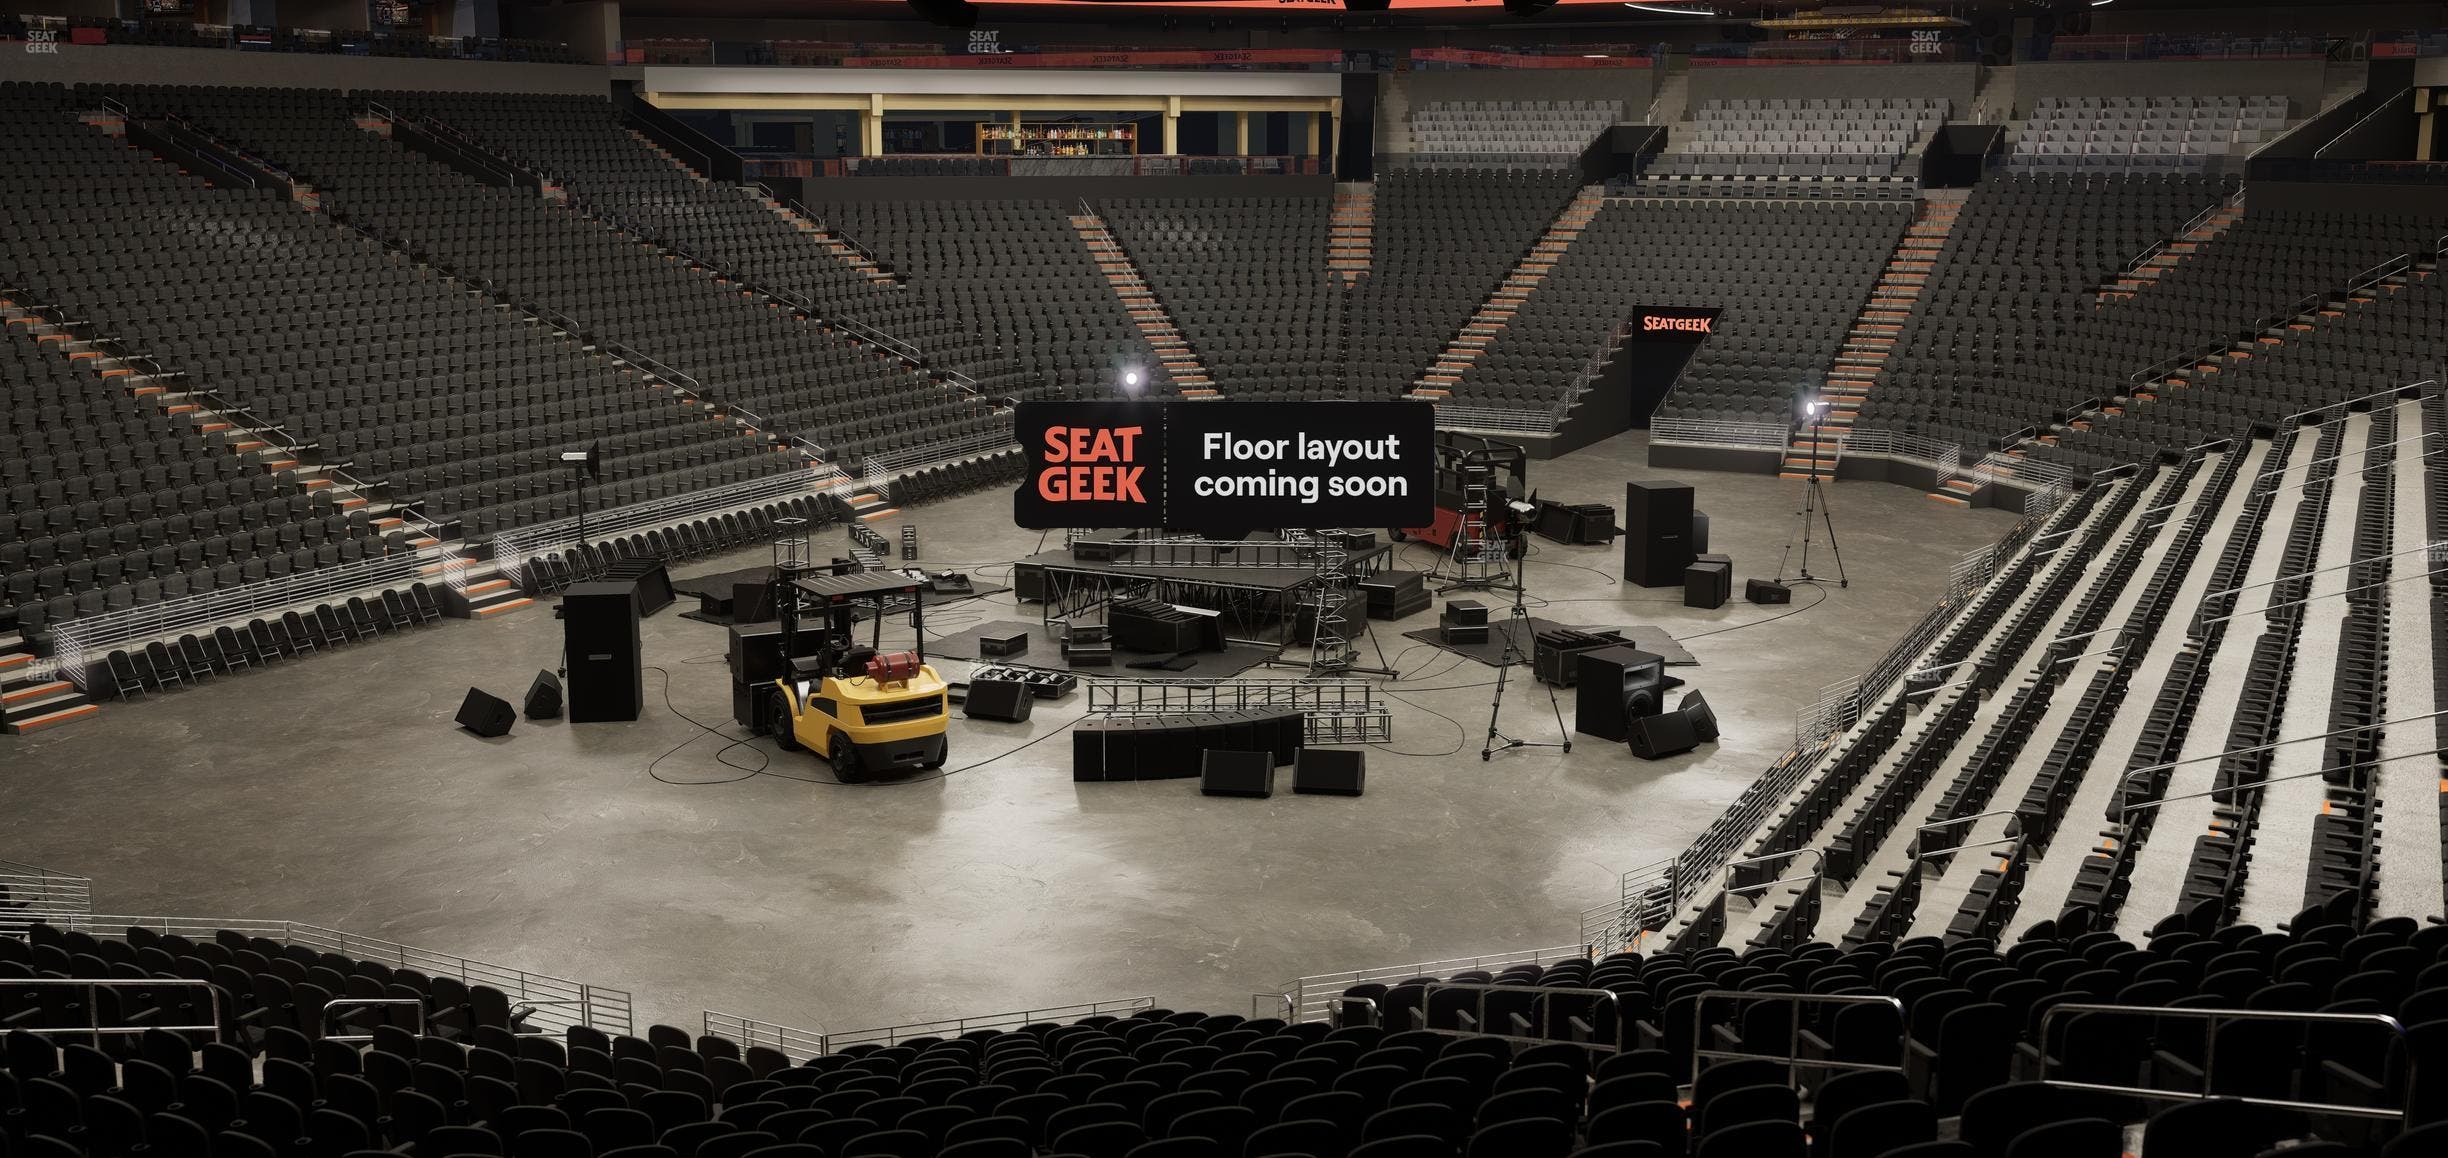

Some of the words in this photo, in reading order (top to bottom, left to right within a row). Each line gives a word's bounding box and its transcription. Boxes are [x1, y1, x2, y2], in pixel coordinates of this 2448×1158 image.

[1643, 316, 1712, 333] SEATGEEK
[1045, 426, 1142, 463] SEAT
[1204, 432, 1290, 460] Floor
[1299, 432, 1400, 467] layout
[1039, 466, 1147, 503] GEEK
[1194, 469, 1319, 503] coming
[1328, 476, 1408, 496] soon
